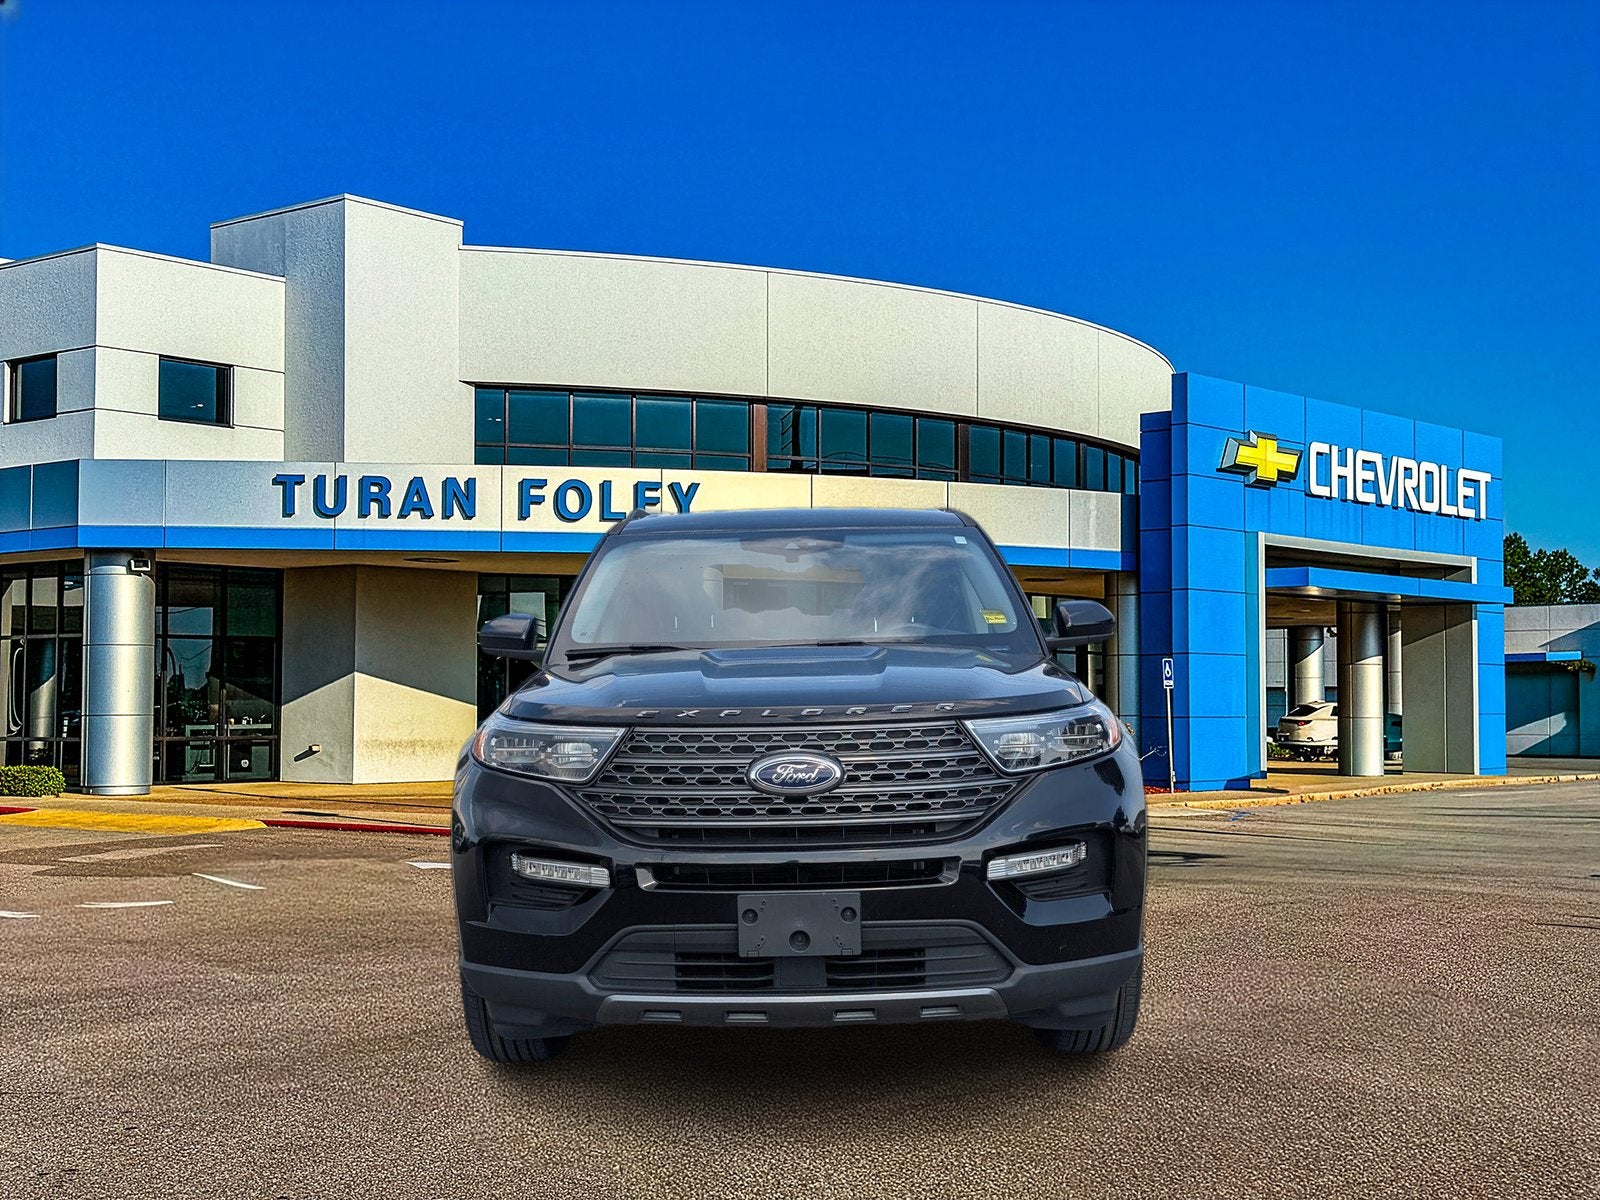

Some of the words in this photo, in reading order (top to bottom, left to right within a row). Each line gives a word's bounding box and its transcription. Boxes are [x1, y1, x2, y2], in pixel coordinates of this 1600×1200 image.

[272, 473, 477, 521] TURAN
[517, 478, 701, 522] FOLEY
[1309, 441, 1492, 520] CHEVROLET
[636, 702, 957, 719] EXPLORER
[771, 763, 824, 784] Ford
